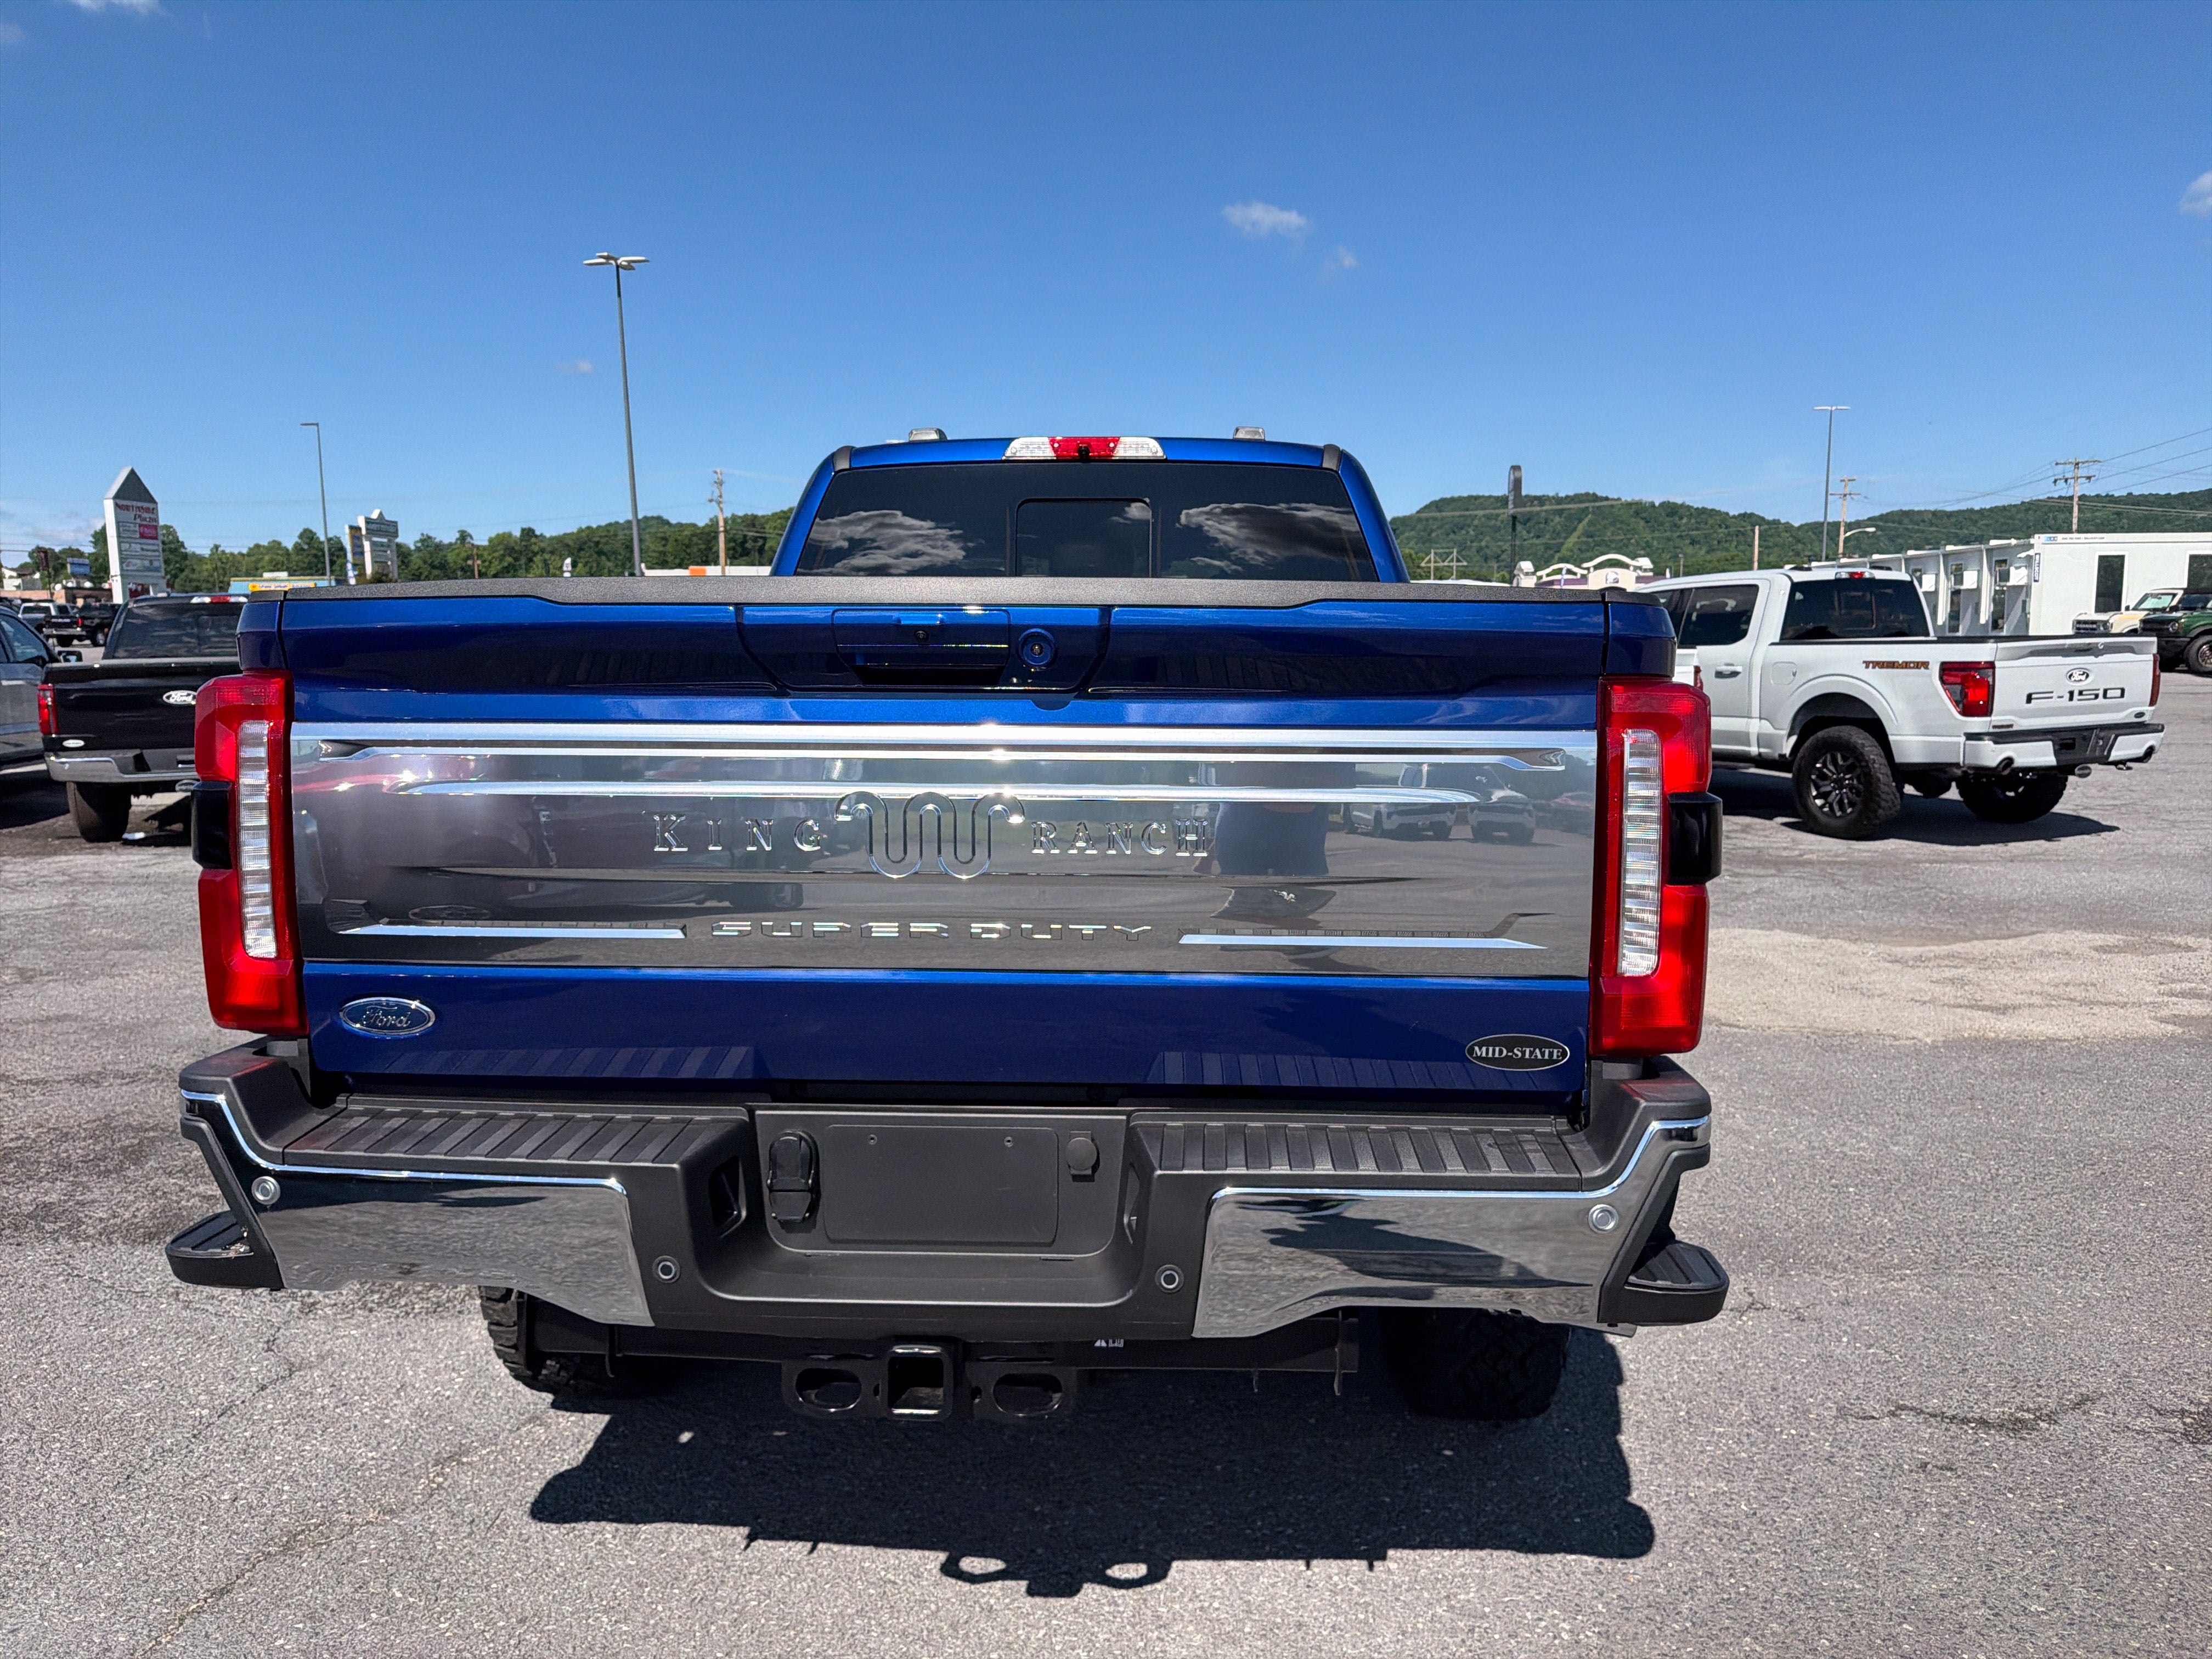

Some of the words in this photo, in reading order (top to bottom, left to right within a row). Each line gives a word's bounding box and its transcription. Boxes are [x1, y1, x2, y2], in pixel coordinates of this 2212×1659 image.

[1863, 661, 1929, 669] TREMOR
[2071, 670, 2087, 681] Ford
[170, 693, 194, 702] Ford
[2025, 687, 2125, 704] F-150
[653, 814, 821, 851] KING
[1031, 818, 1207, 857] RANCH
[712, 921, 949, 939] SUPER
[969, 923, 1152, 941] DUTY
[363, 1005, 411, 1028] Ford
[1472, 1046, 1562, 1060] MID-STATE
